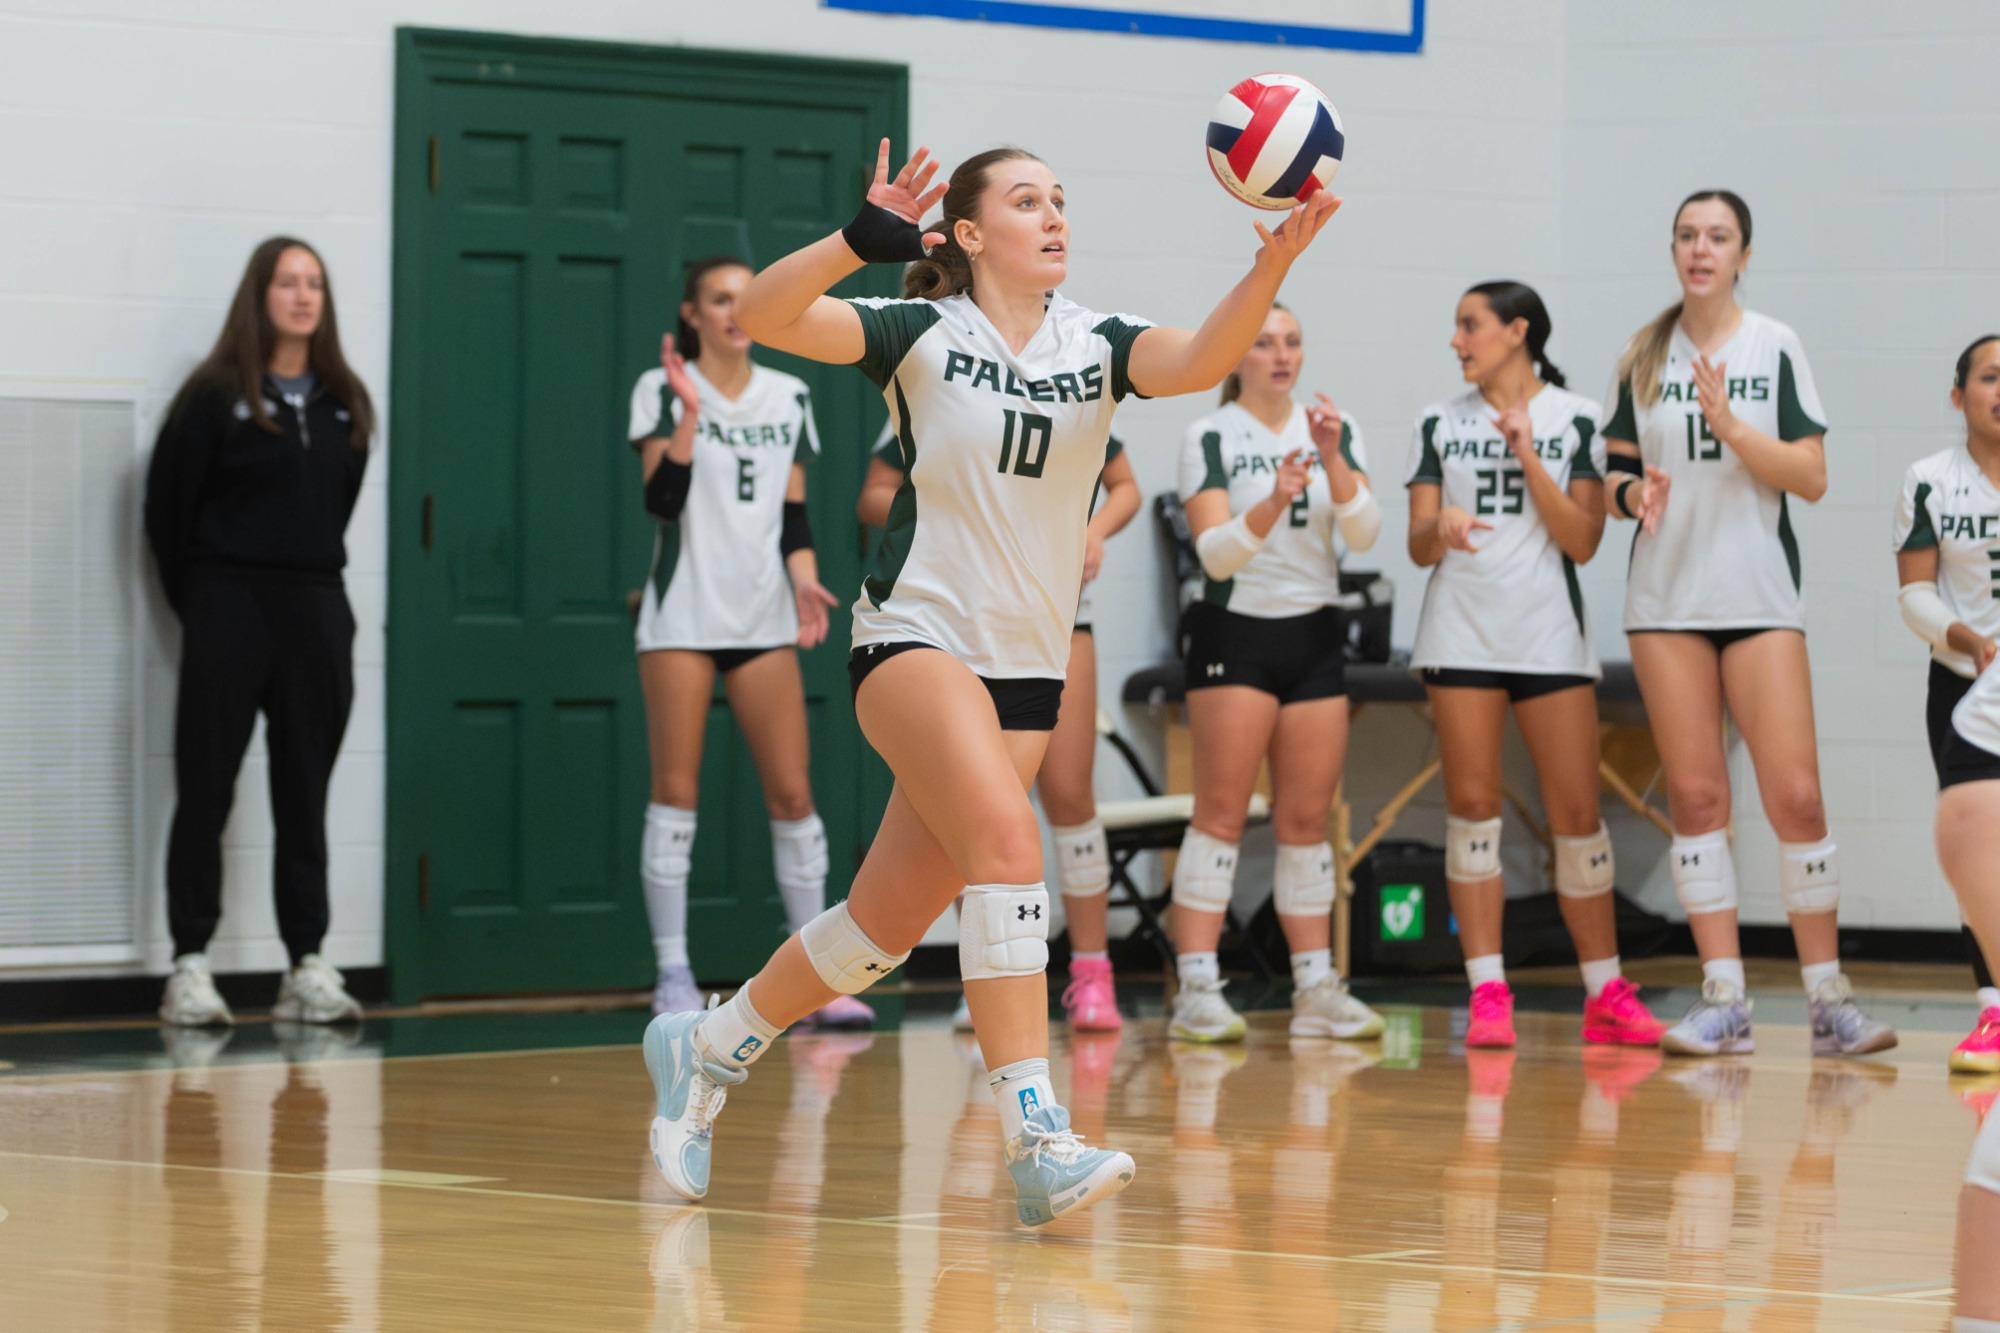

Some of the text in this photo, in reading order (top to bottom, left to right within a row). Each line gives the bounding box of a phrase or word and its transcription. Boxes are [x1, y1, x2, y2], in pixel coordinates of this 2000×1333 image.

[998, 408, 1052, 479] 10
[738, 458, 754, 501] 6
[1476, 470, 1525, 515] 25
